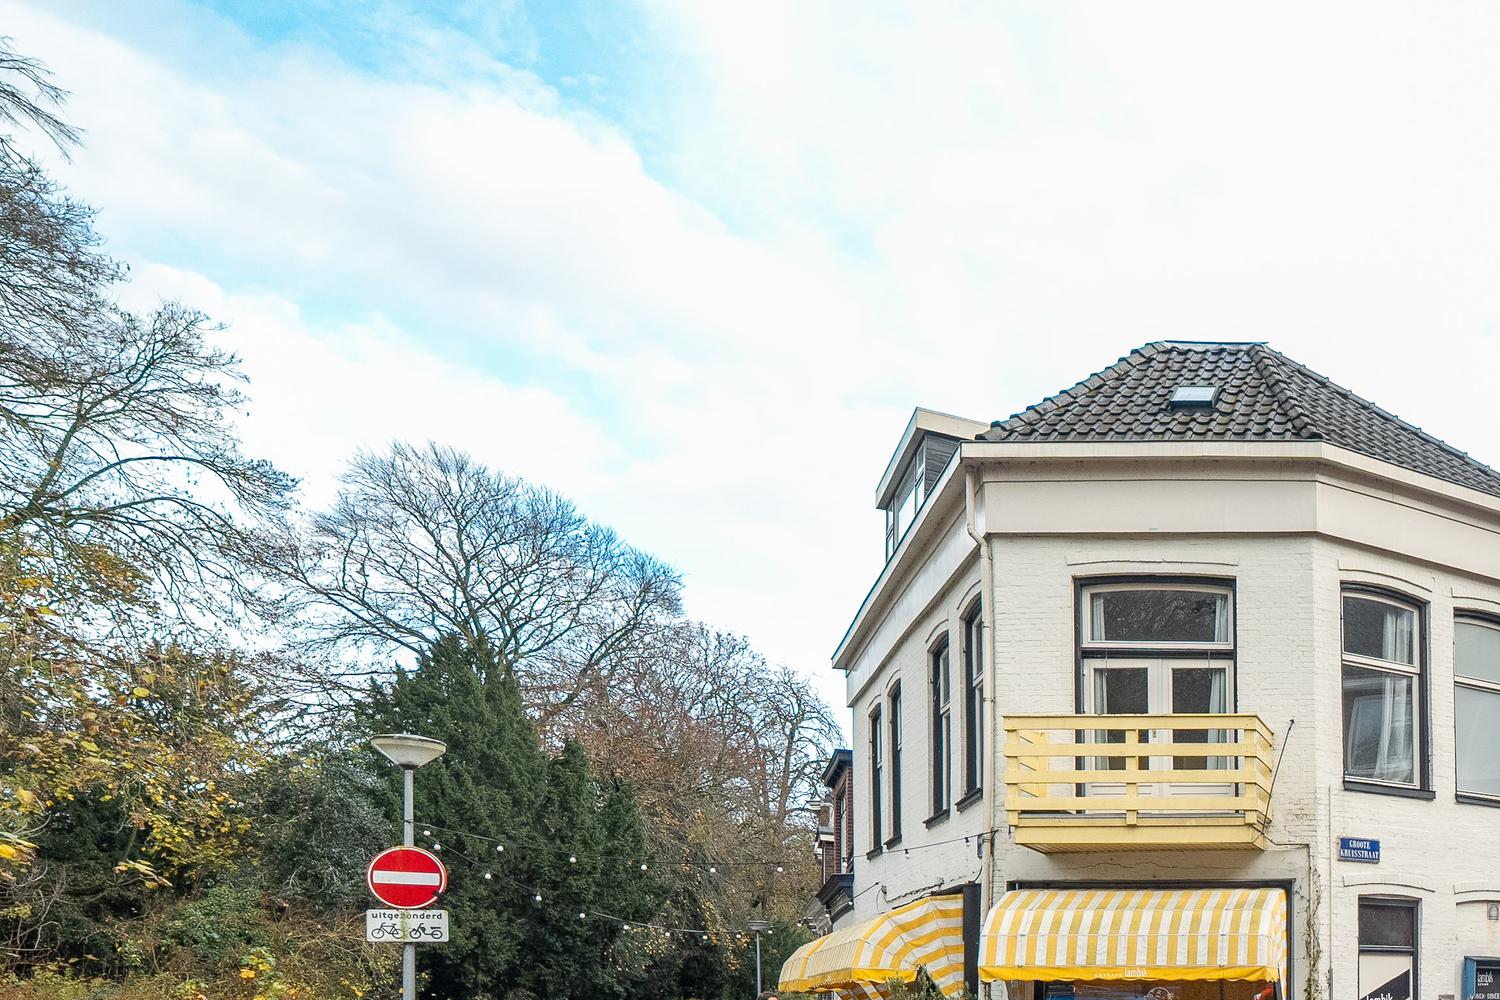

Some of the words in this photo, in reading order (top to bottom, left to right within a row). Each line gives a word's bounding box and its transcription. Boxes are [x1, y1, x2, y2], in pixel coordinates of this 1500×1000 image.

[1349, 840, 1371, 849] GROOTE
[1340, 849, 1379, 859] KRUISSTRAAT
[371, 912, 442, 920] uitgezonderd
[1124, 967, 1148, 977] lambik
